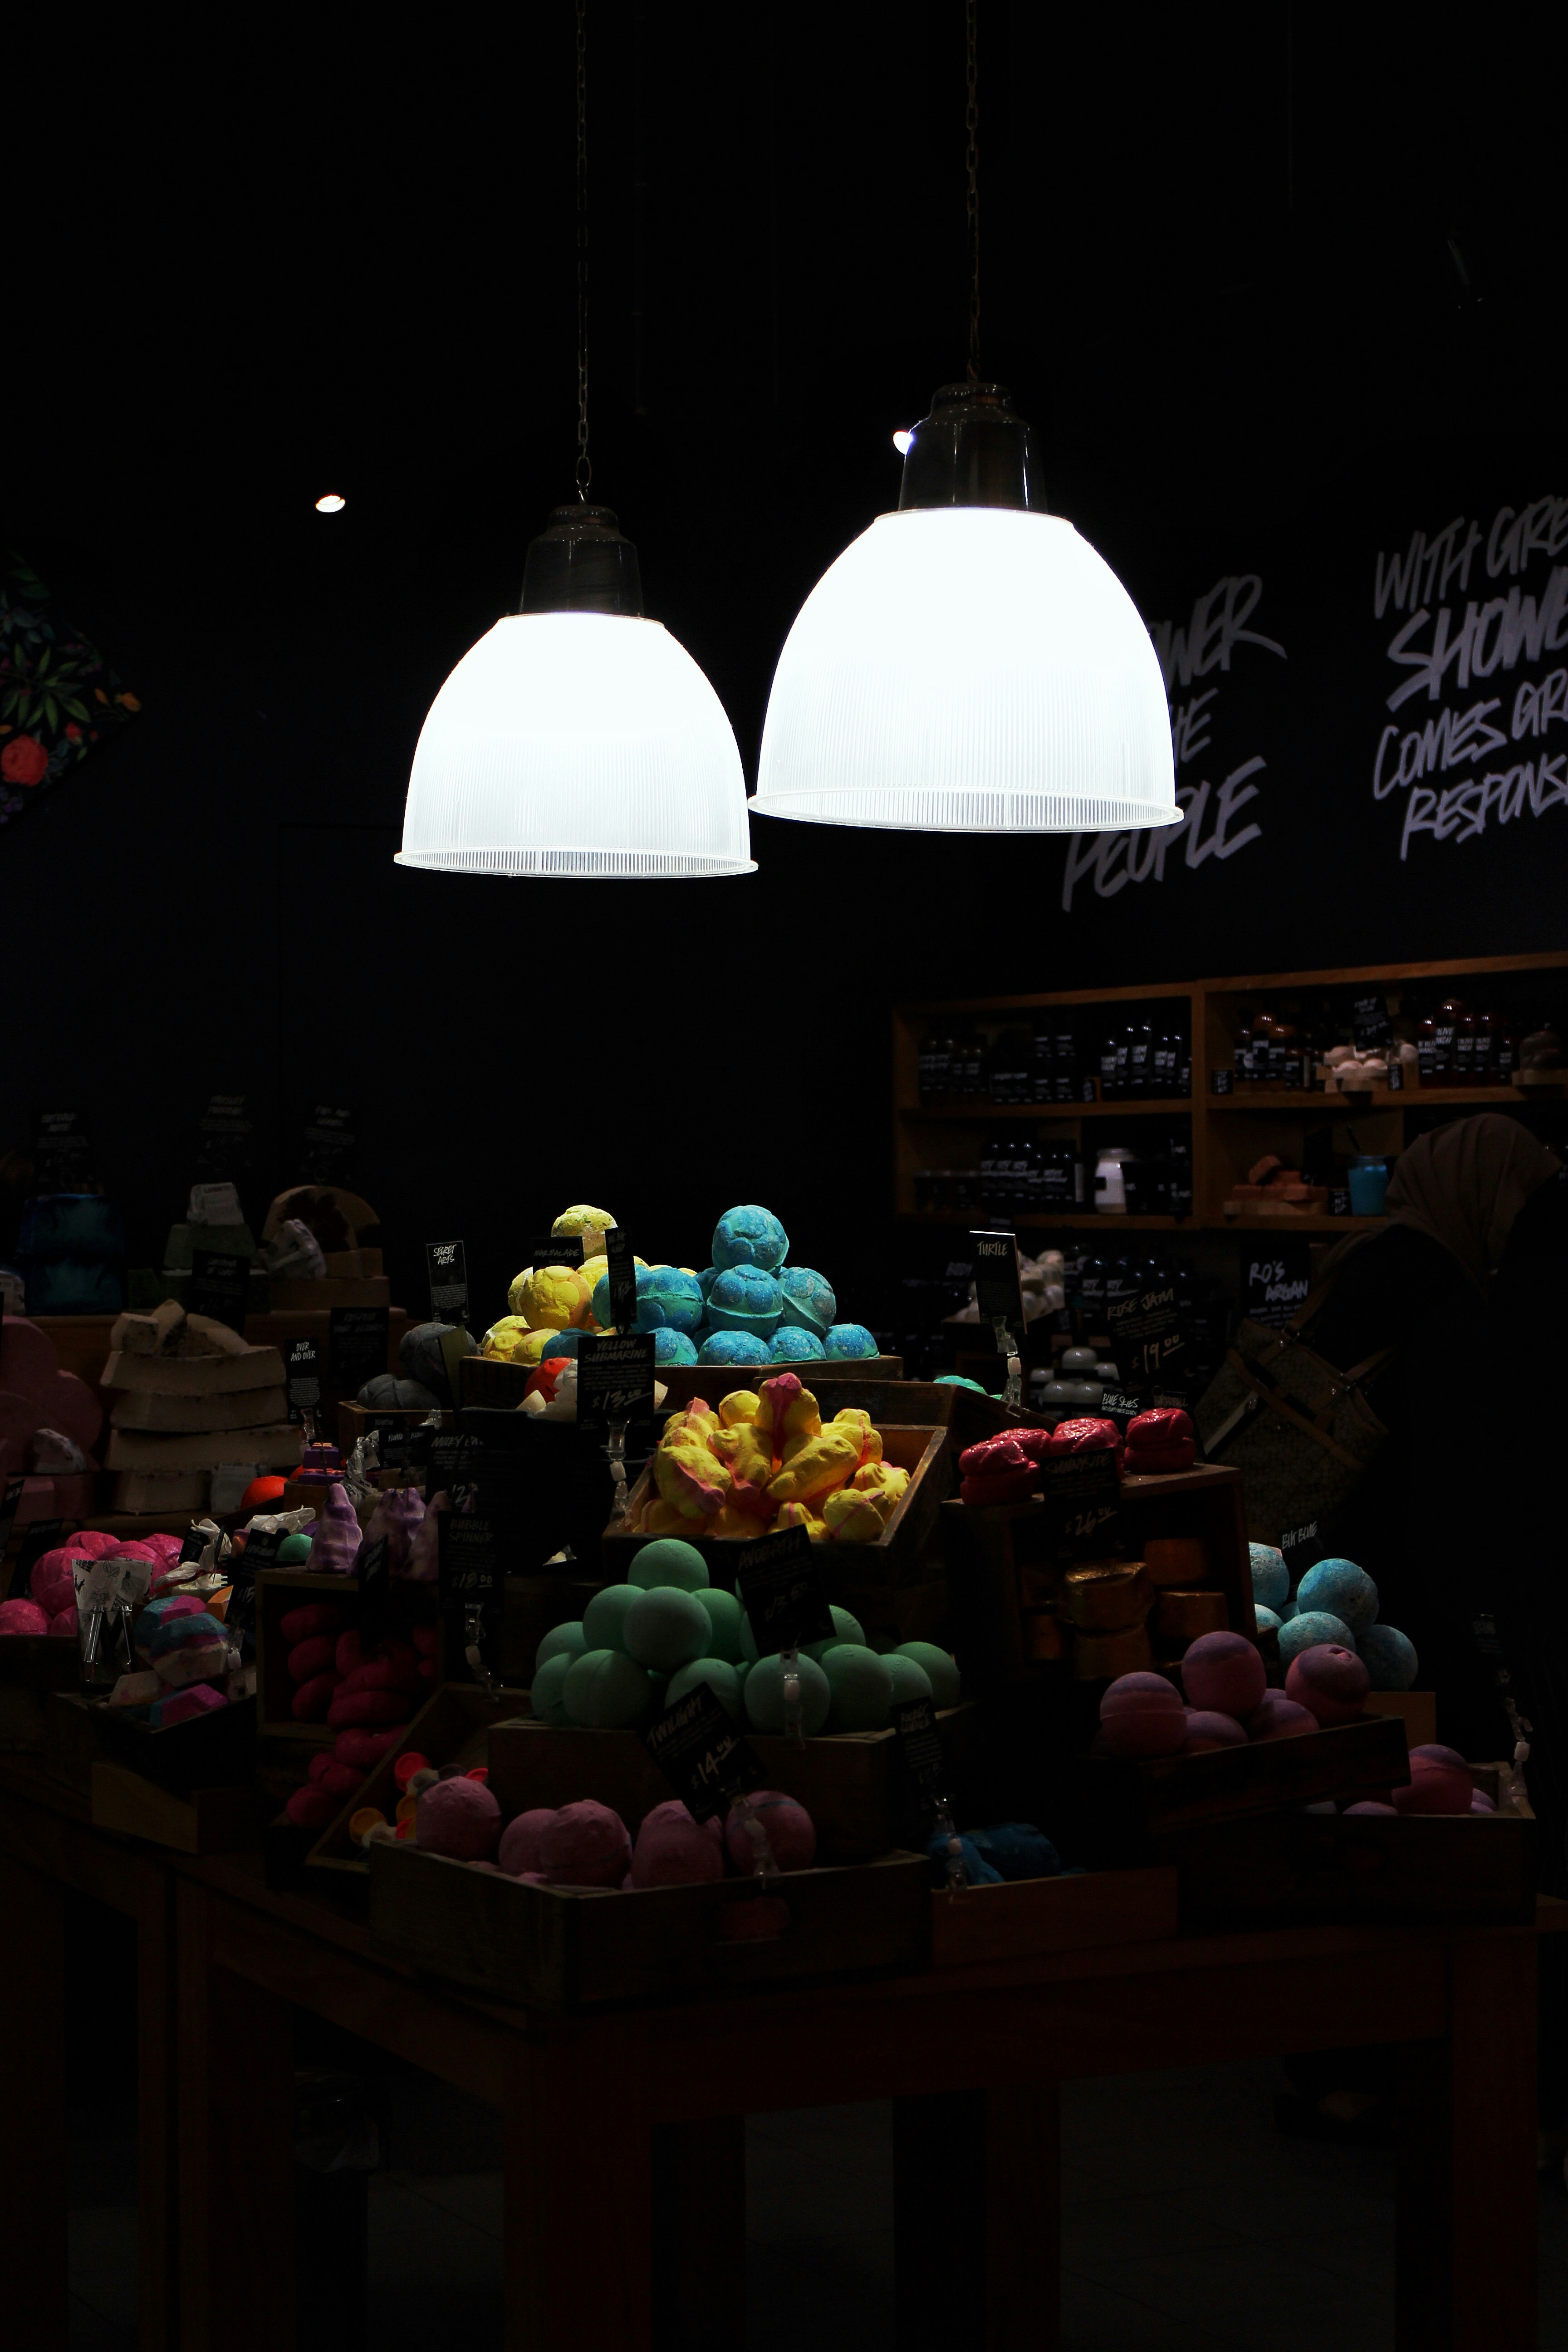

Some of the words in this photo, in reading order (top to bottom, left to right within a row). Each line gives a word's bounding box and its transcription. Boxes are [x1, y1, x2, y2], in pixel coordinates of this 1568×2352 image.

[1373, 515, 1483, 620] WITH
[1372, 697, 1508, 802] COMES
[433, 1244, 457, 1257] SECRET
[534, 1248, 580, 1258] MARMALADE
[977, 1241, 1008, 1256] TURTLE
[438, 1254, 455, 1265] ARTS
[1264, 1279, 1309, 1303] ARGAN
[1107, 1297, 1137, 1321] ROSE
[1140, 1288, 1175, 1310] JAM
[296, 1341, 310, 1352] OVER
[597, 1339, 637, 1352] YELLOW
[290, 1352, 302, 1362] AND
[303, 1350, 316, 1361] OVER
[583, 1348, 650, 1363] SUBMARINE
[1102, 1393, 1120, 1406] BLUE
[1118, 1396, 1139, 1408] SKIES
[431, 1434, 465, 1448] MILKY
[1045, 1451, 1112, 1474] SUNNYSIDE
[451, 1518, 490, 1531] BUBBLE
[448, 1531, 494, 1543] SPINNER
[1282, 1529, 1298, 1550] BIG
[1298, 1520, 1318, 1543] BLUE
[646, 1690, 707, 1750] TWILIGHT
